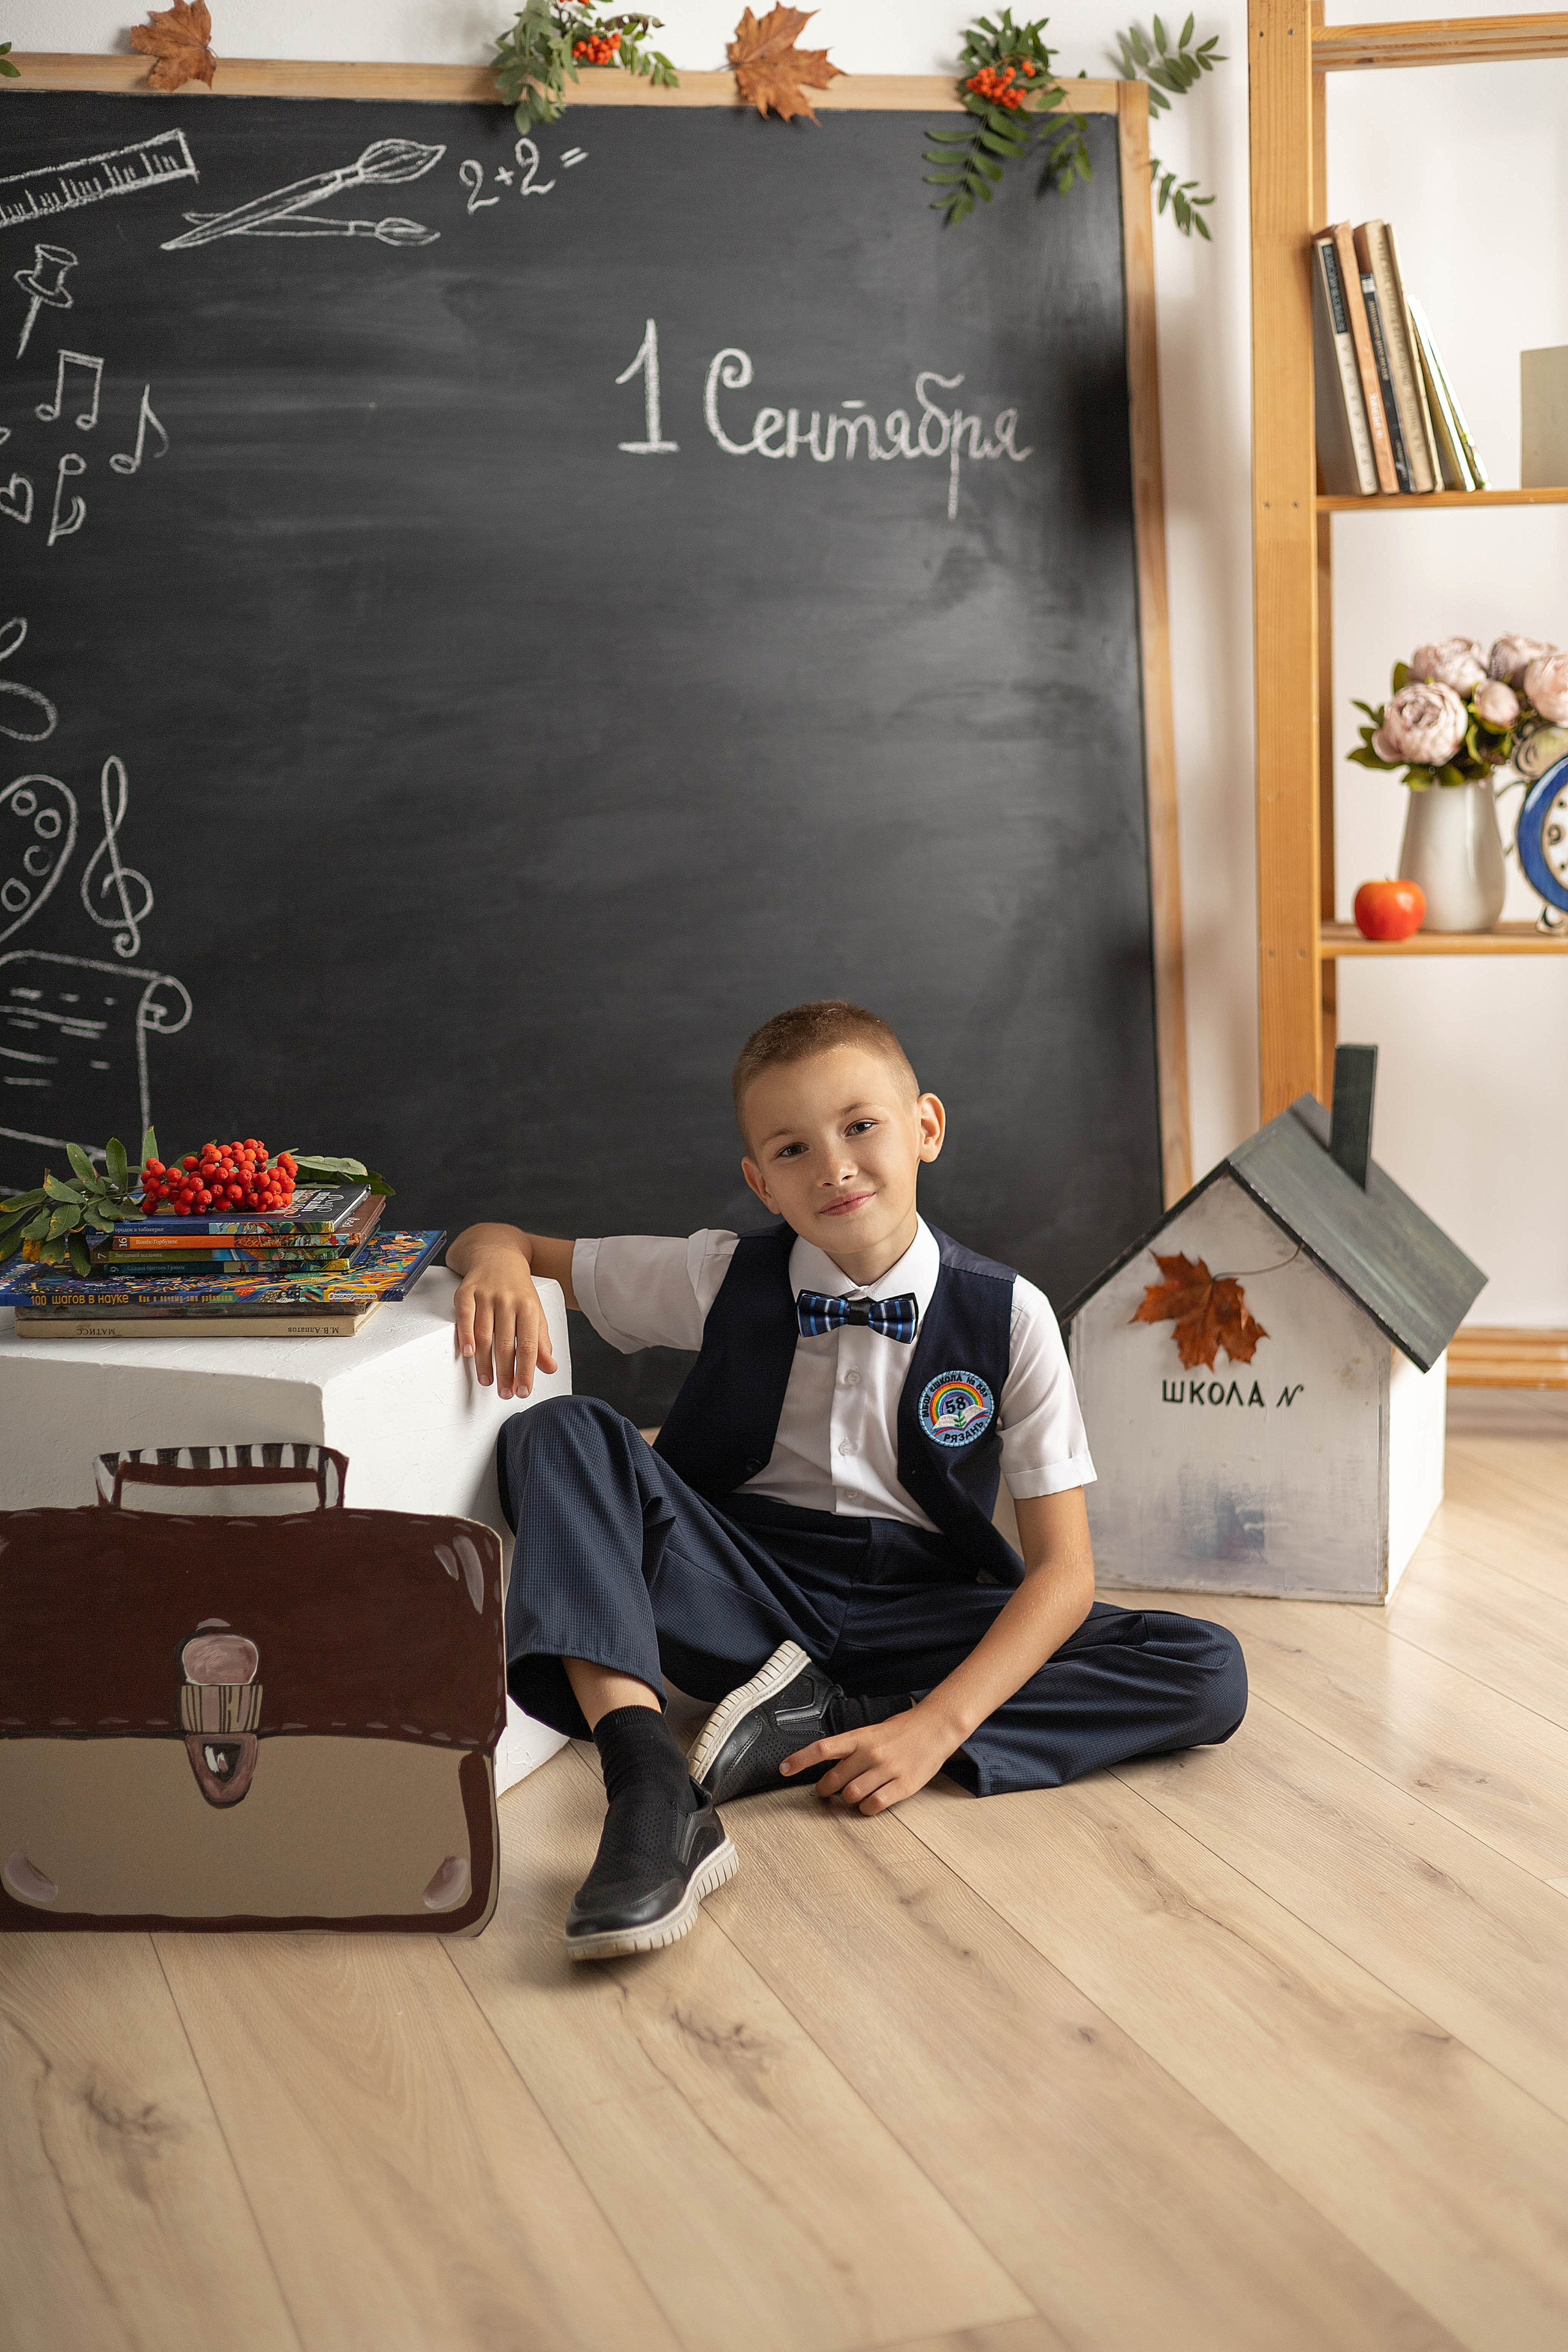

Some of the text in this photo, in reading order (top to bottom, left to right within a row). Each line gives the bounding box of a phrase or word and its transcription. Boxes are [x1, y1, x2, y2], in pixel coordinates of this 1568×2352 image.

[615, 318, 1036, 521] 1 Сентября
[118, 1238, 127, 1248] 16
[31, 1294, 129, 1305] 100 шагов в науке
[1161, 1379, 1265, 1408] ШКОЛА
[922, 1393, 931, 1417] МБОУ
[945, 1396, 966, 1414] 58
[943, 1422, 984, 1442] РЯЗАНЬ
